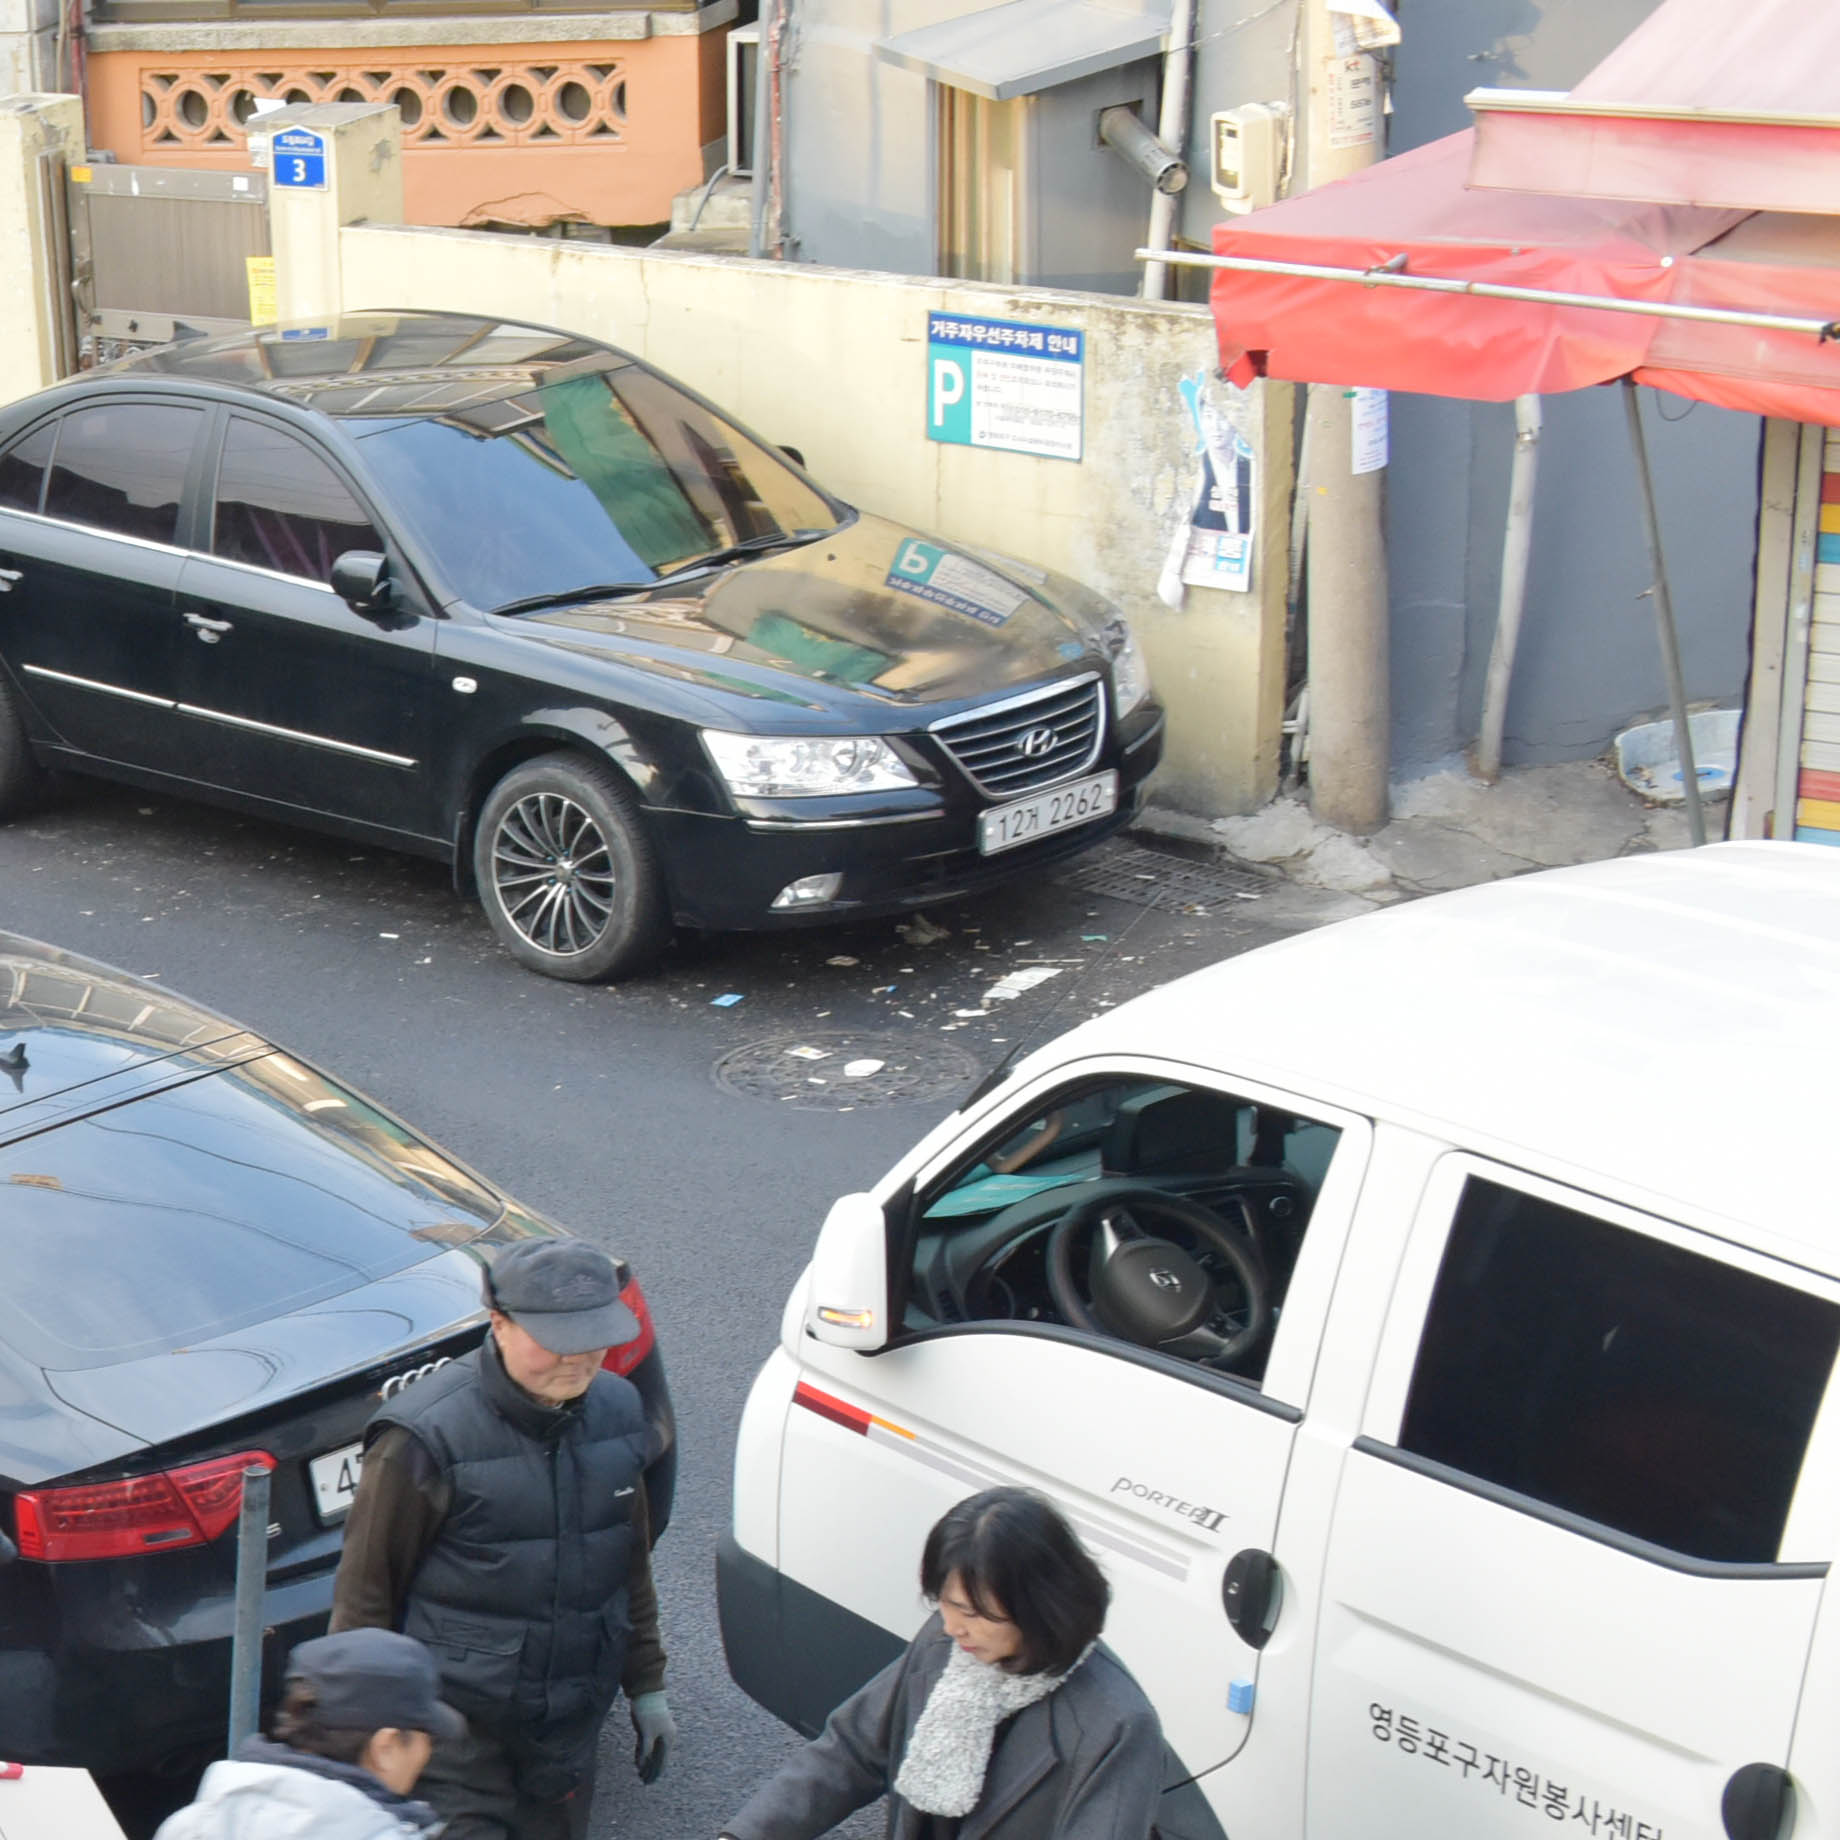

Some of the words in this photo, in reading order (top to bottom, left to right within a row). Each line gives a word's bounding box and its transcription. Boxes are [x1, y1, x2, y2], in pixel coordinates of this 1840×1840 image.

[292, 158, 306, 182] 3
[931, 320, 1044, 351] 거주자우선주차제
[1047, 333, 1077, 354] 안내
[934, 359, 965, 427] P
[1049, 782, 1103, 827] 2262
[1111, 1477, 1204, 1519] PORTER
